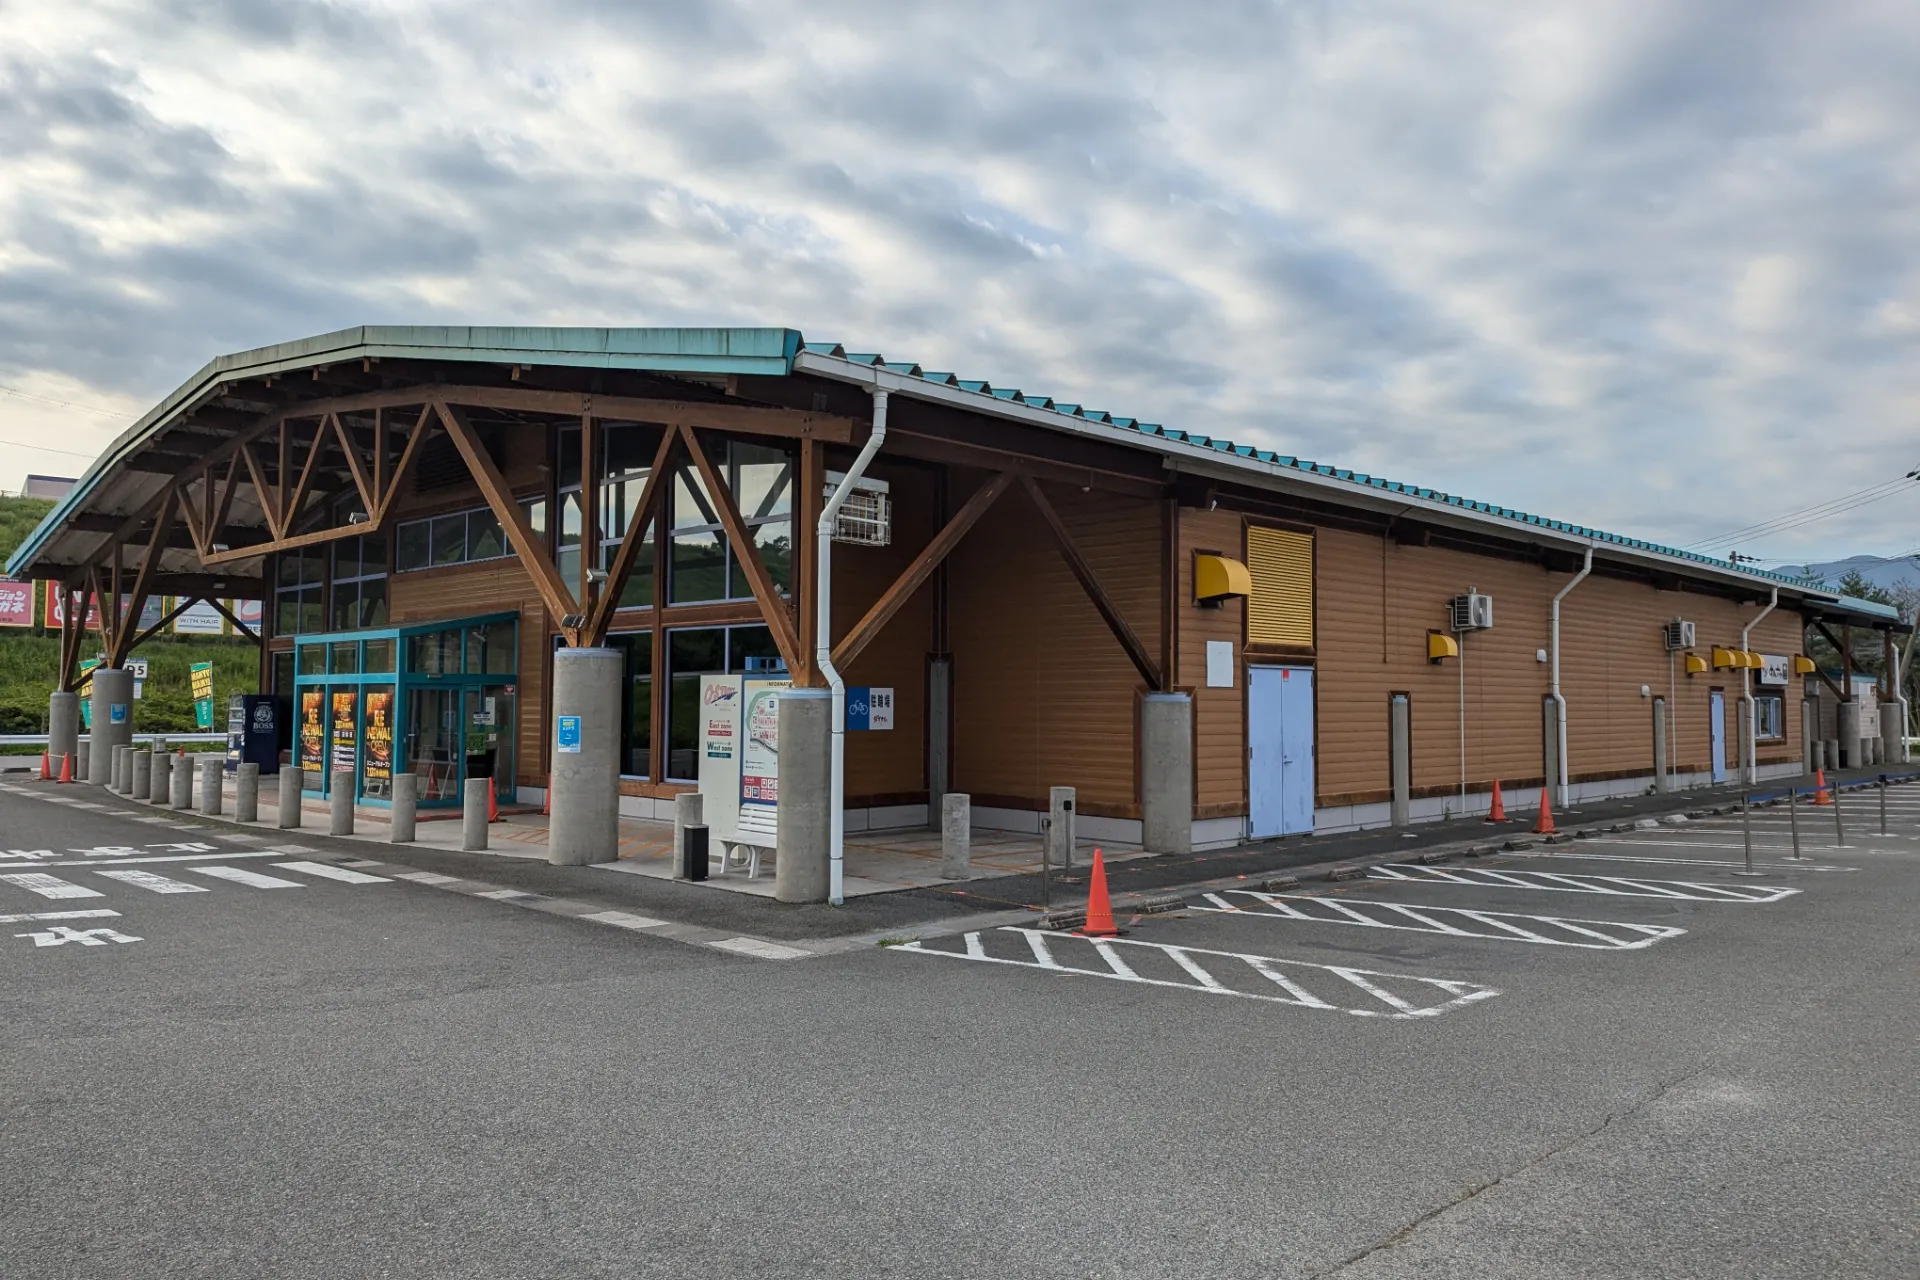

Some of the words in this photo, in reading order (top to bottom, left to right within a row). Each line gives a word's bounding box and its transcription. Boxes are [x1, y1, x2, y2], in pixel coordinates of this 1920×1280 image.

[374, 710, 385, 726] RE
[252, 722, 274, 730] BOSS
[709, 719, 720, 729] East
[367, 727, 391, 740] NEWAL
[706, 740, 720, 751] West
